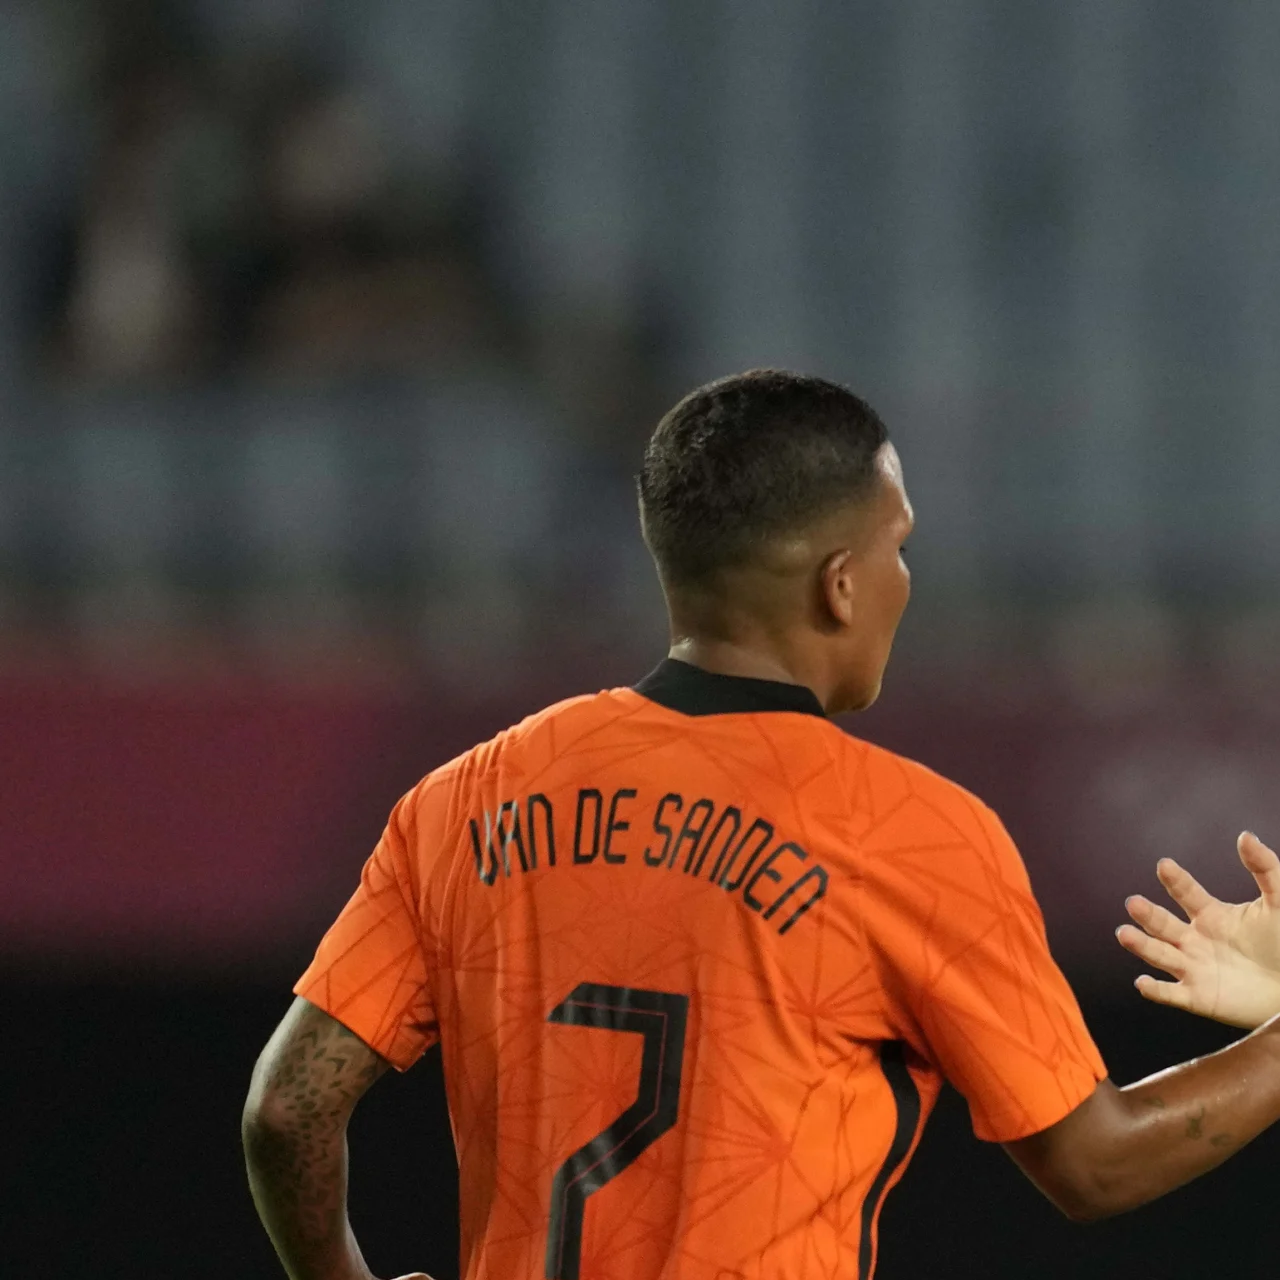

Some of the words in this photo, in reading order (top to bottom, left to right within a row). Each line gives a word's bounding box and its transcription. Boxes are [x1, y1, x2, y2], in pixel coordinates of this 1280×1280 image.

[468, 792, 557, 887] VAN
[571, 788, 638, 865] DE
[643, 792, 830, 937] SANDEN
